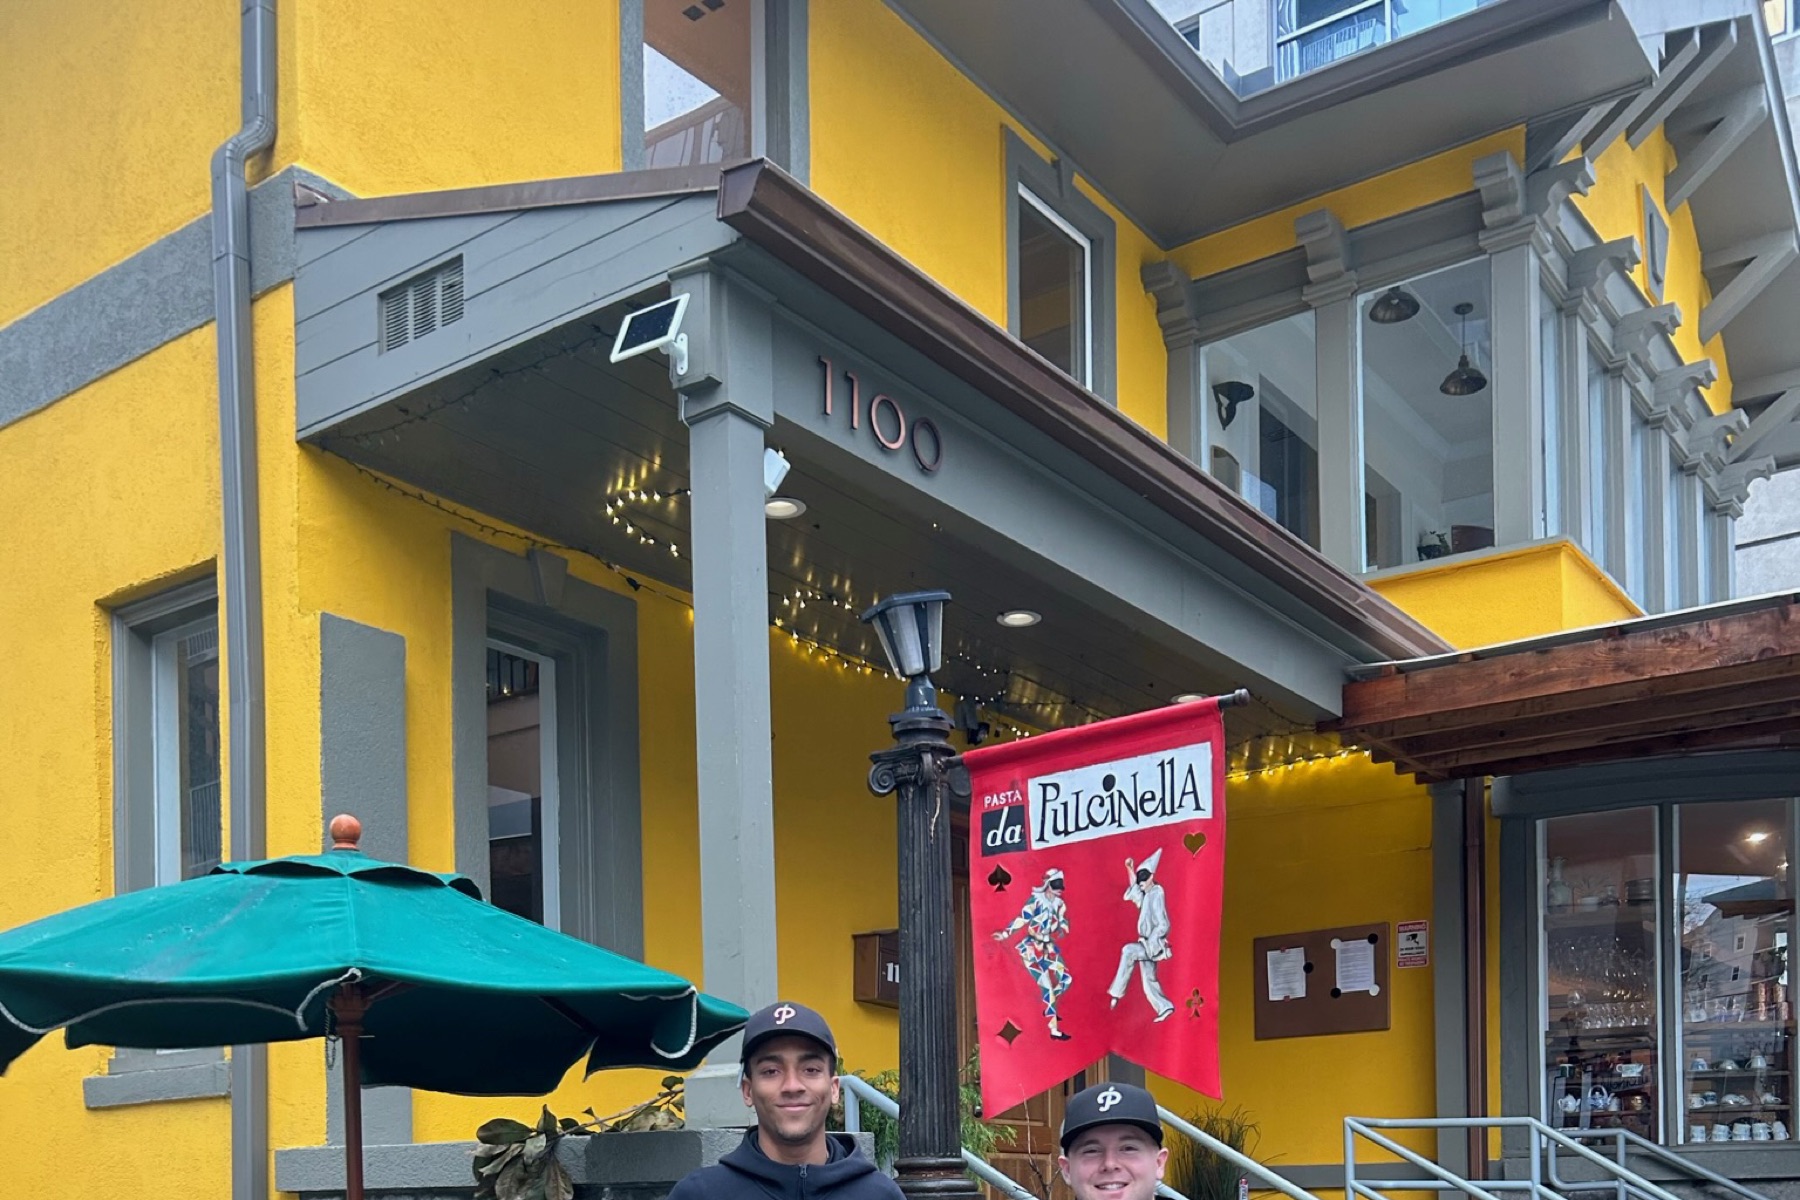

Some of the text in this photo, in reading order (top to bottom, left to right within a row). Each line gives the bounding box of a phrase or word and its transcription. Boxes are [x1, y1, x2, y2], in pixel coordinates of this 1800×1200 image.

[818, 355, 943, 472] 1100
[984, 789, 1023, 808] PASTA
[986, 806, 1022, 847] da
